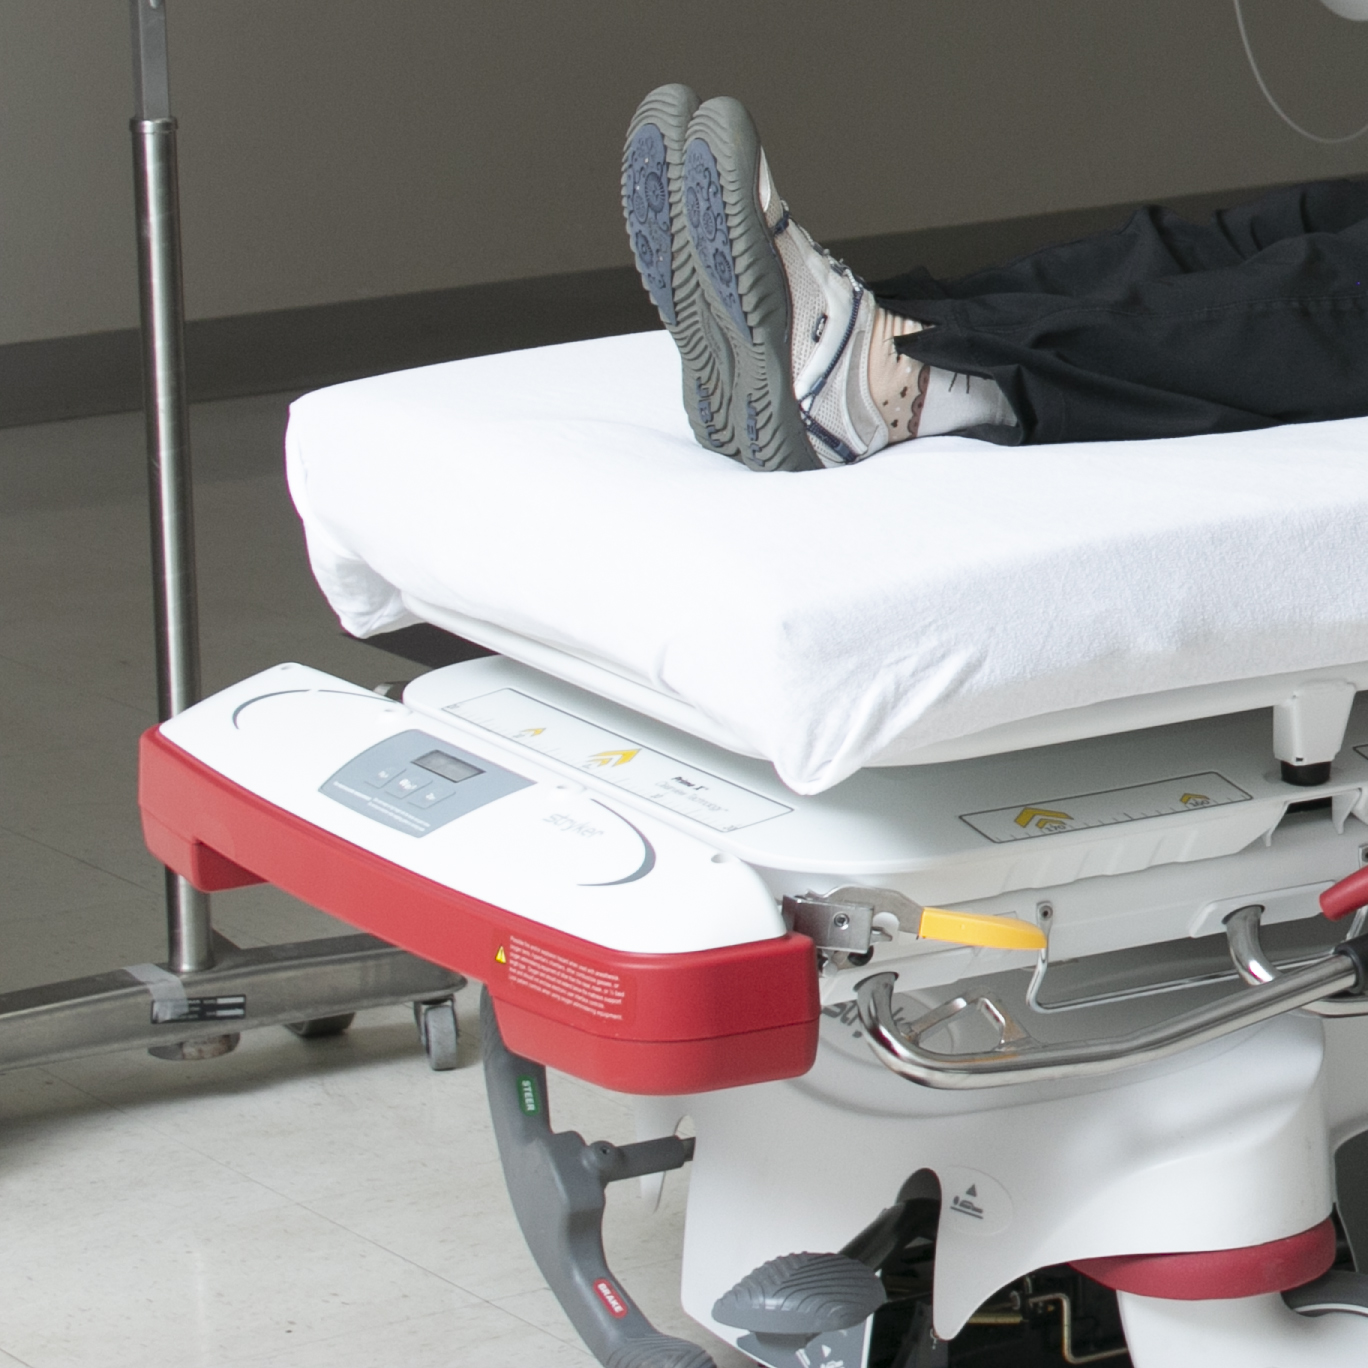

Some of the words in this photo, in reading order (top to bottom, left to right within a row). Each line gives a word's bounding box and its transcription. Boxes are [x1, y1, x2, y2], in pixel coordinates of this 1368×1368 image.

[541, 812, 602, 839] stryker
[521, 1079, 536, 1112] STEER
[597, 1282, 624, 1313] BRAKE
